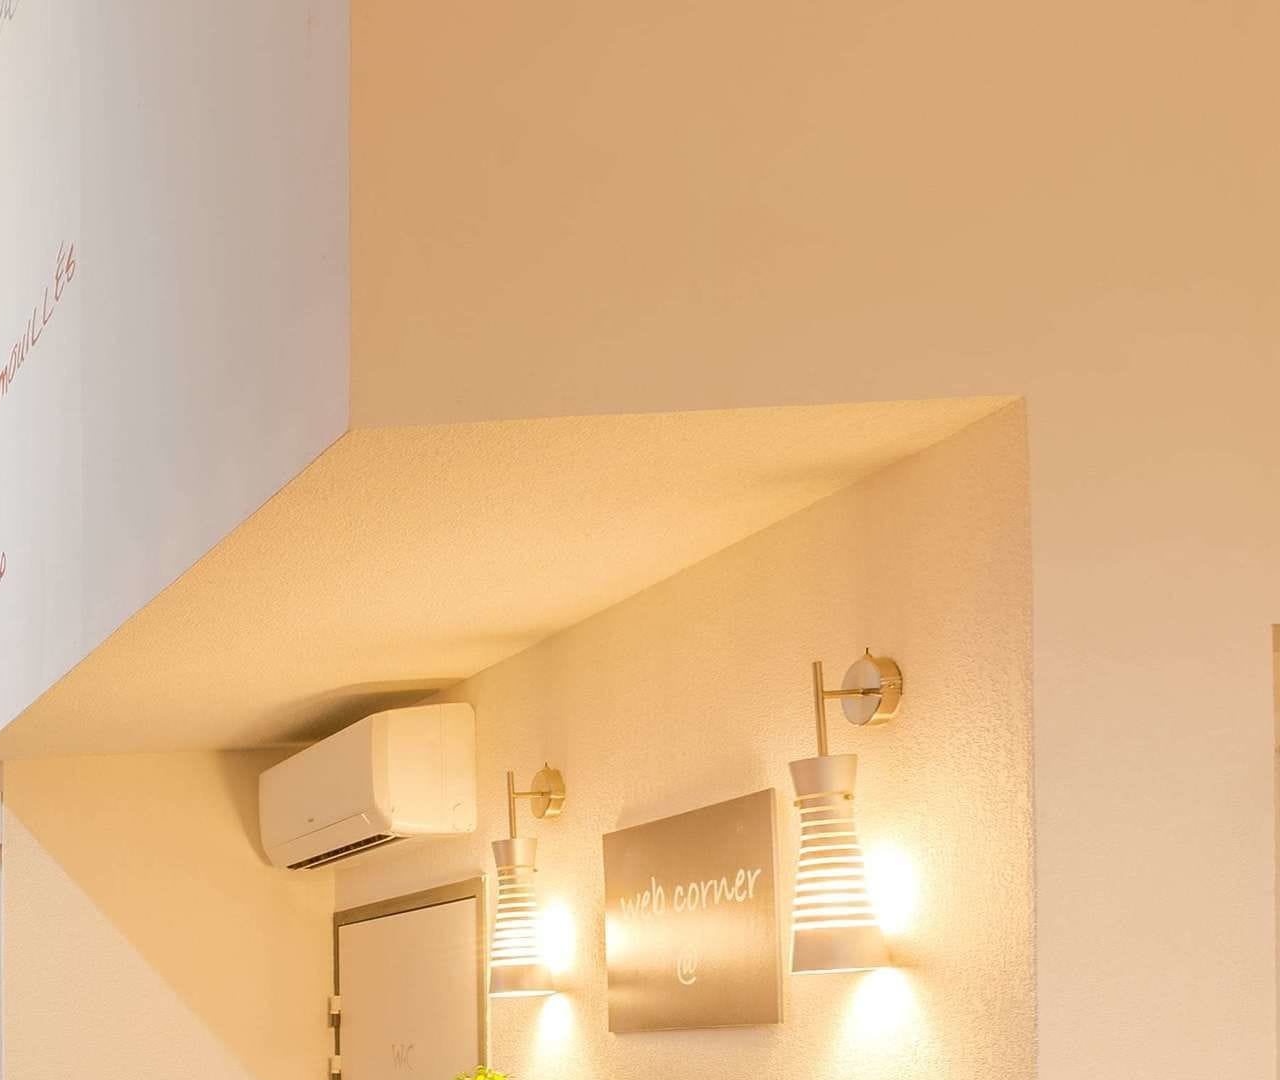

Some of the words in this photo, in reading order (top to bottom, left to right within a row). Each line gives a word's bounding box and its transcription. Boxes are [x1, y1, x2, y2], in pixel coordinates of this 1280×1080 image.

[620, 876, 666, 917] web
[673, 868, 762, 913] corner
[391, 1043, 416, 1072] WC
